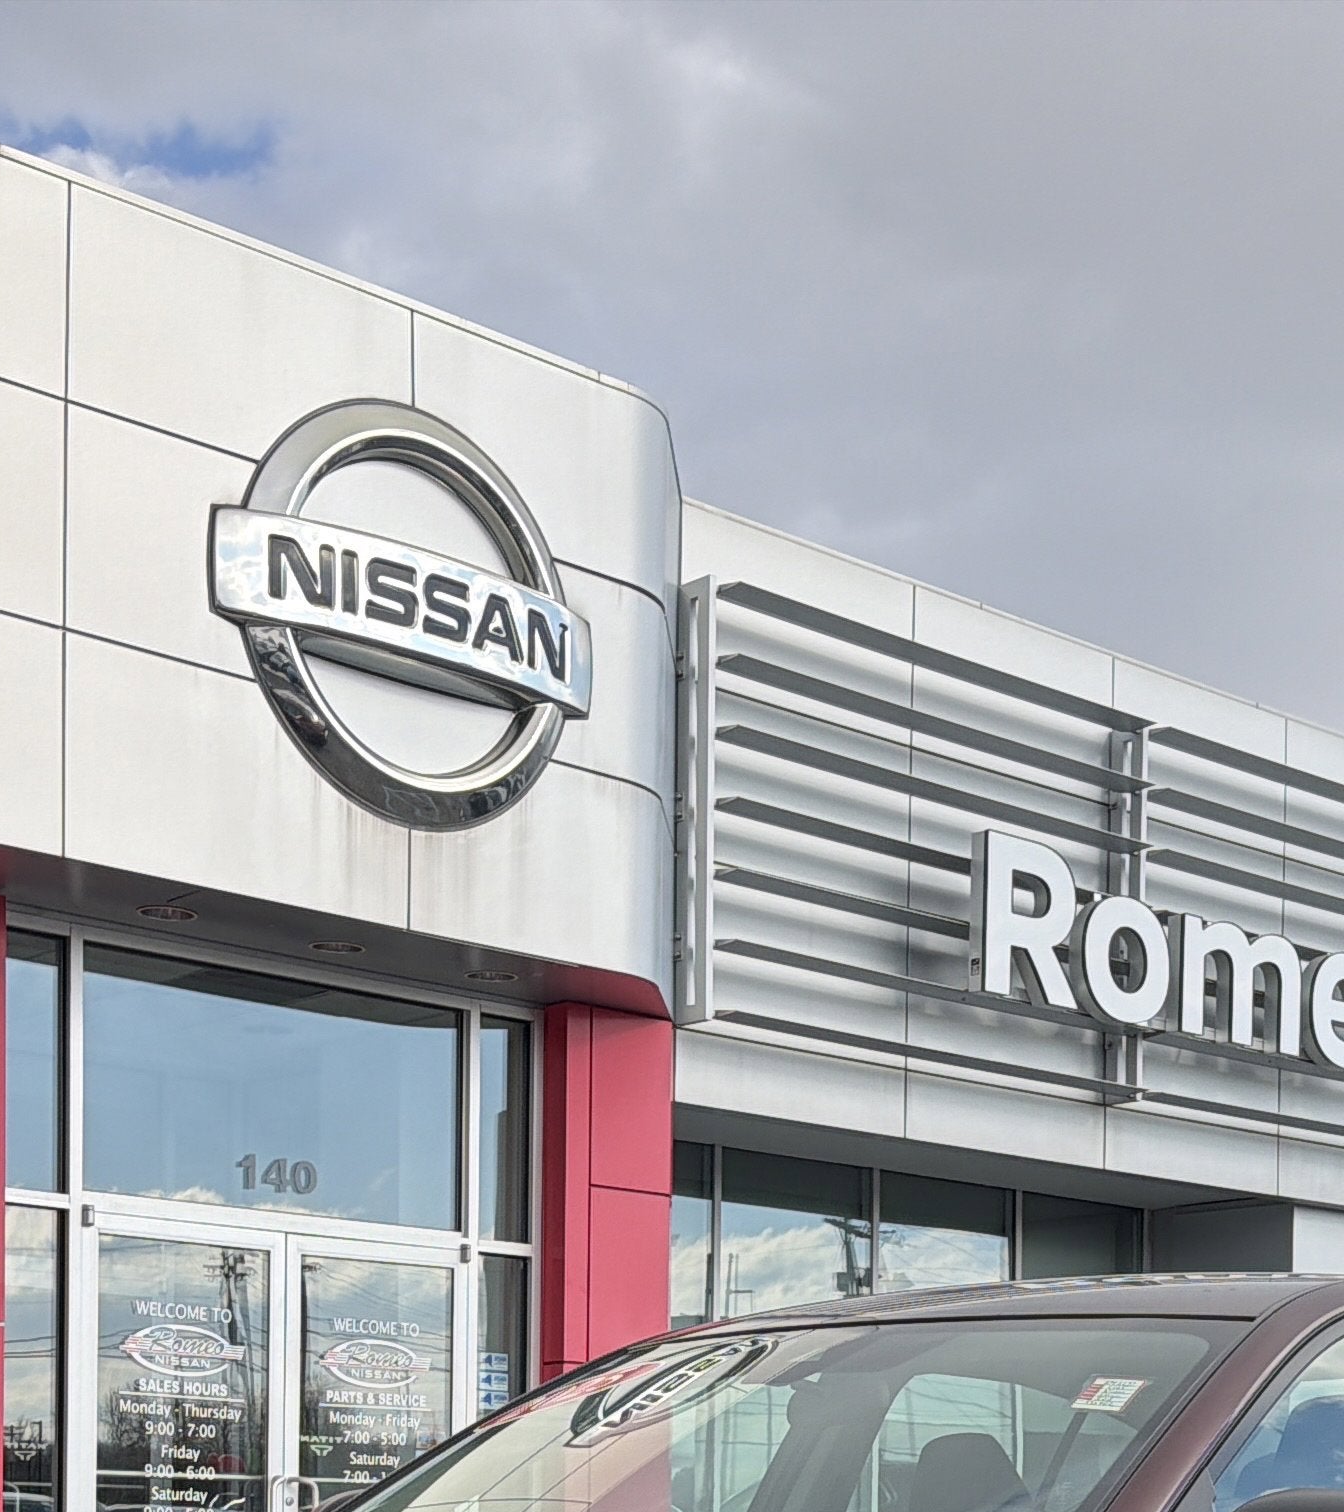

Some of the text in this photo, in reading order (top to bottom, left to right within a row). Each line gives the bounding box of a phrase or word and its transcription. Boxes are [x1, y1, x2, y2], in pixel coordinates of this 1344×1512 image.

[266, 533, 572, 684] NISSAN
[235, 1153, 318, 1195] 140
[136, 1300, 233, 1324] WELCOME TO
[333, 1317, 420, 1338] WELCOME TO
[143, 1327, 225, 1355] Romeo
[155, 1355, 211, 1369] NISSAN
[351, 1368, 402, 1380] NISSAN
[138, 1378, 228, 1397] SALES HOURS
[326, 1390, 427, 1408] PARTS & SERVICE
[119, 1399, 172, 1417] Monday
[183, 1403, 243, 1423] Thursday
[145, 1421, 175, 1437] 9:00
[187, 1423, 216, 1438] 7:00
[329, 1411, 375, 1427] Monday
[385, 1414, 421, 1431] Friday
[343, 1431, 370, 1445] 7:00
[381, 1432, 406, 1446] 5:00
[161, 1445, 201, 1462] Friday
[349, 1451, 401, 1468] Saturday
[144, 1463, 174, 1479] 9:00
[186, 1465, 216, 1481] 6:00
[343, 1470, 370, 1484] 7:00
[150, 1486, 208, 1504] Saturday
